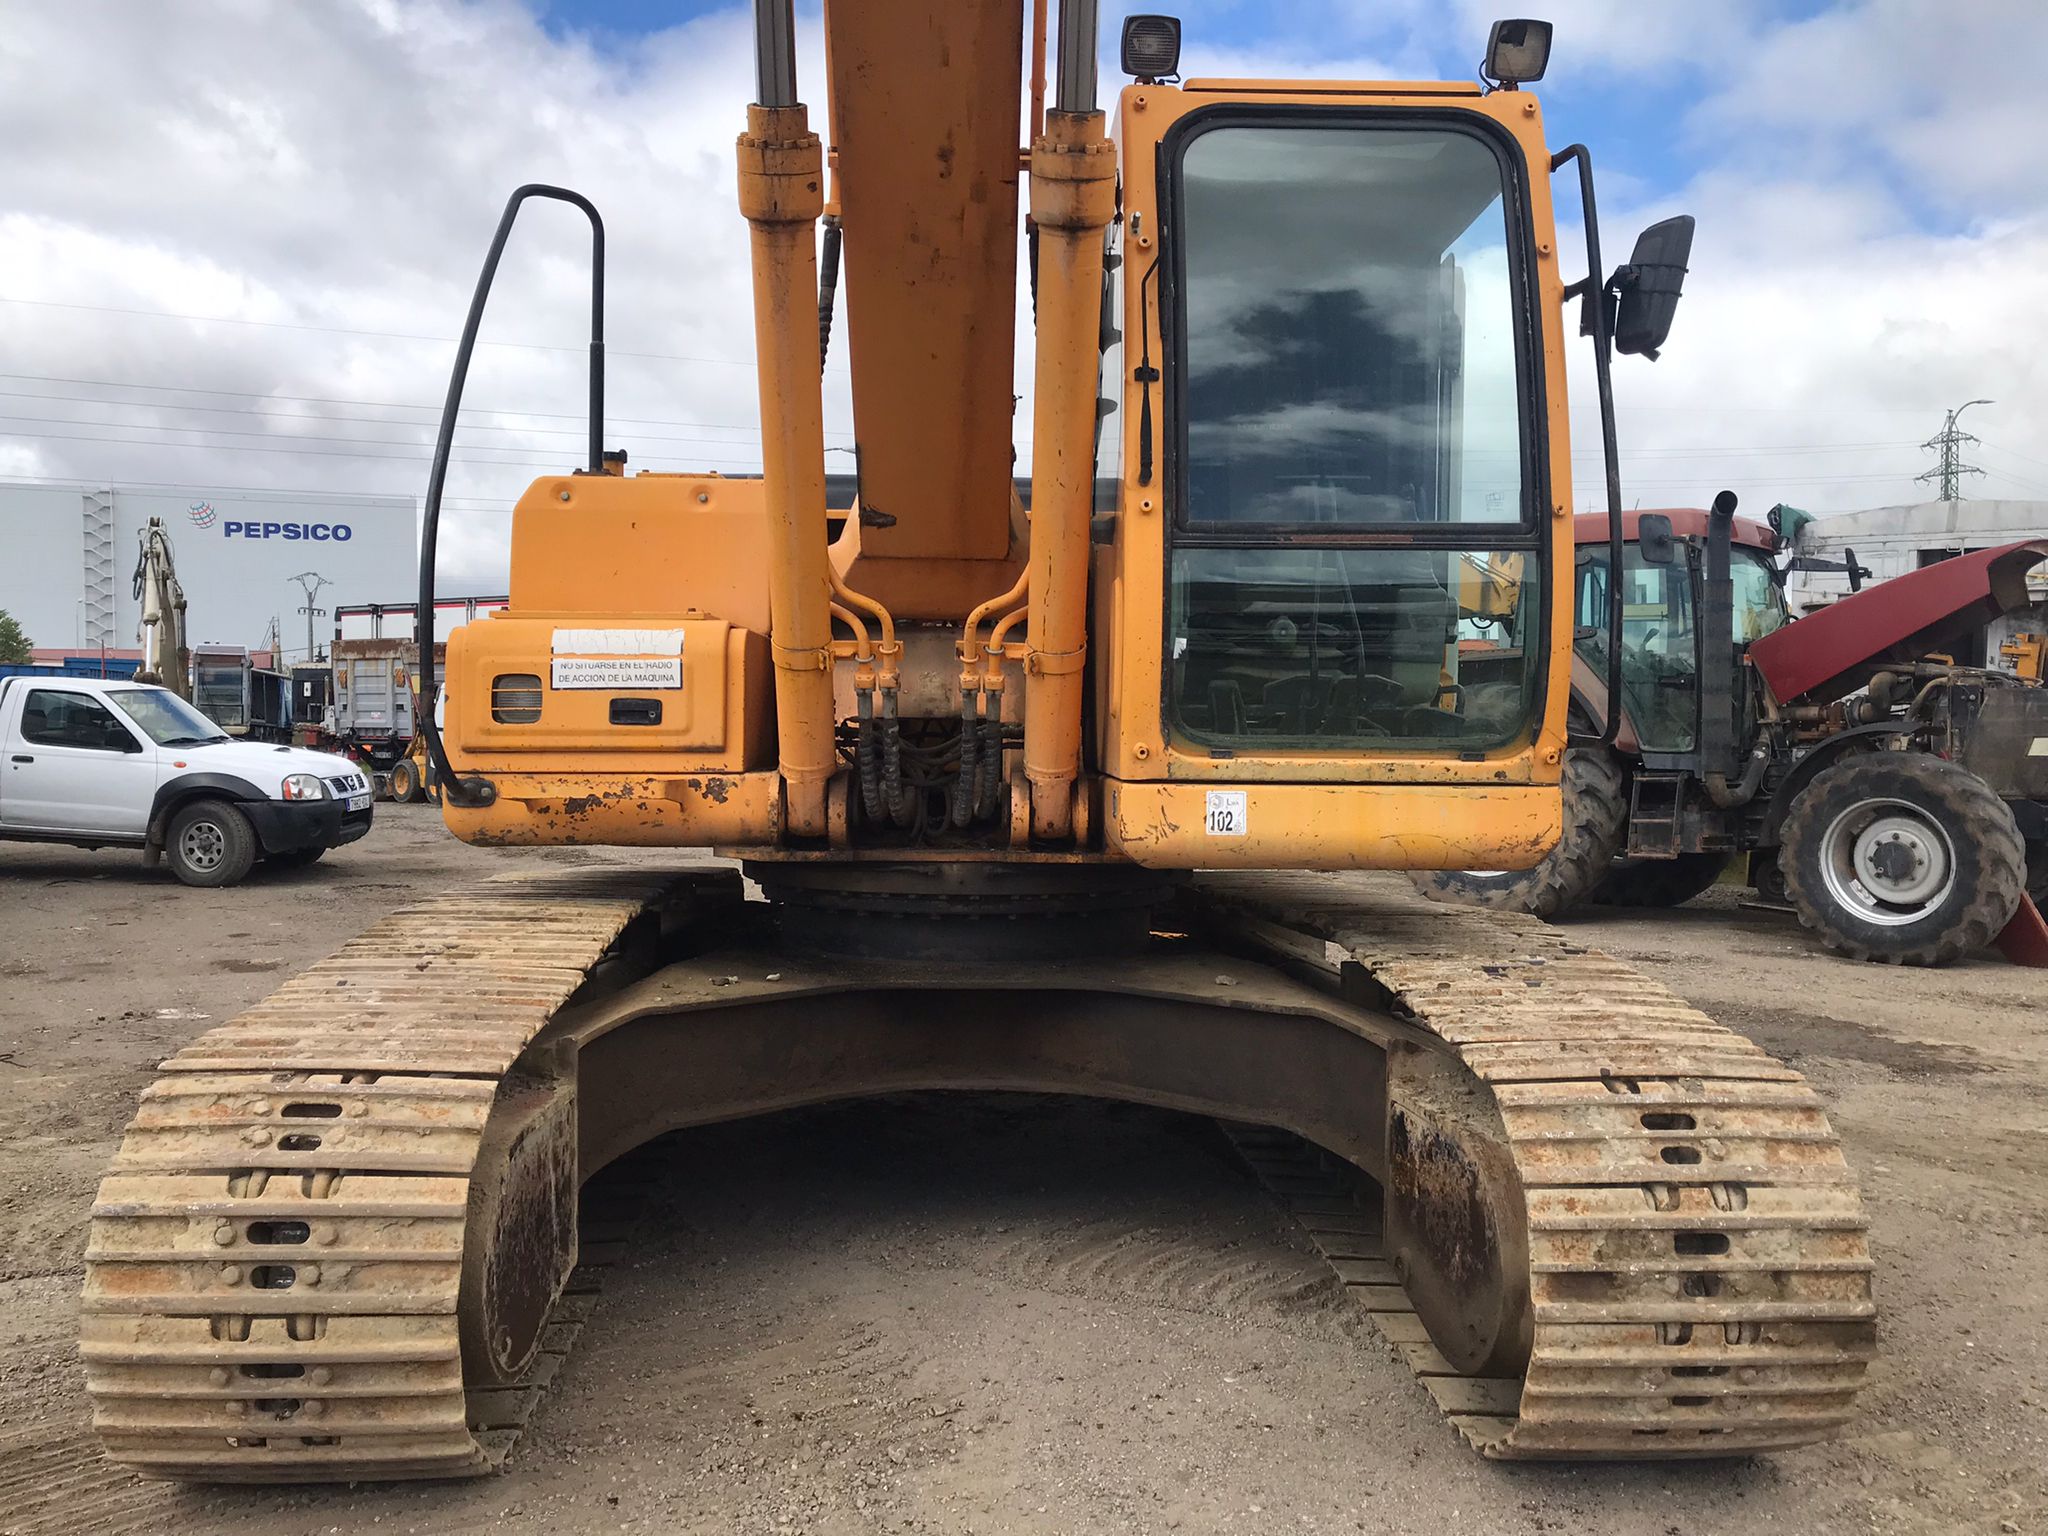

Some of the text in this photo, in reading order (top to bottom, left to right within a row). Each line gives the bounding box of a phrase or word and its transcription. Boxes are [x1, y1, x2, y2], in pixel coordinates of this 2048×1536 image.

[224, 521, 352, 541] PEPSICO
[560, 661, 673, 670] NO SITUARSE EN EL RADIO
[558, 673, 675, 682] DE ACCION DE LA MAQUINA
[1210, 810, 1233, 832] 102
